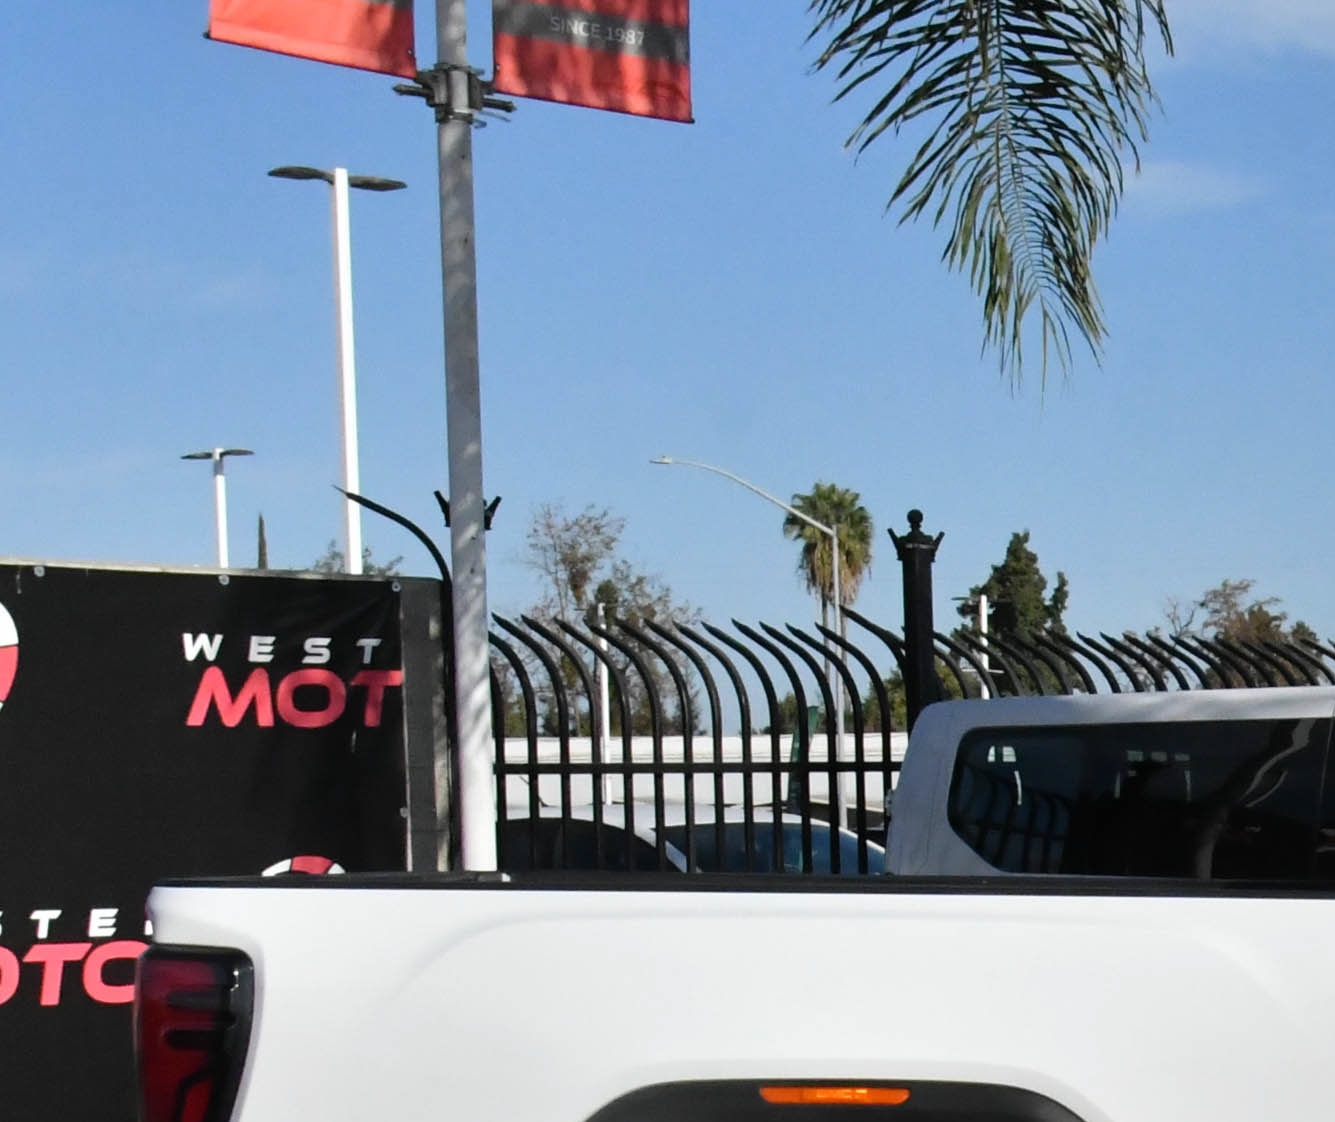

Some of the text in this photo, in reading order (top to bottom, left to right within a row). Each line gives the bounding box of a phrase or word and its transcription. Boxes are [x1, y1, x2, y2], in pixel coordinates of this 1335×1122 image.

[551, 16, 645, 46] SINCE 1987
[182, 632, 382, 664] WEST
[185, 665, 404, 728] MOT
